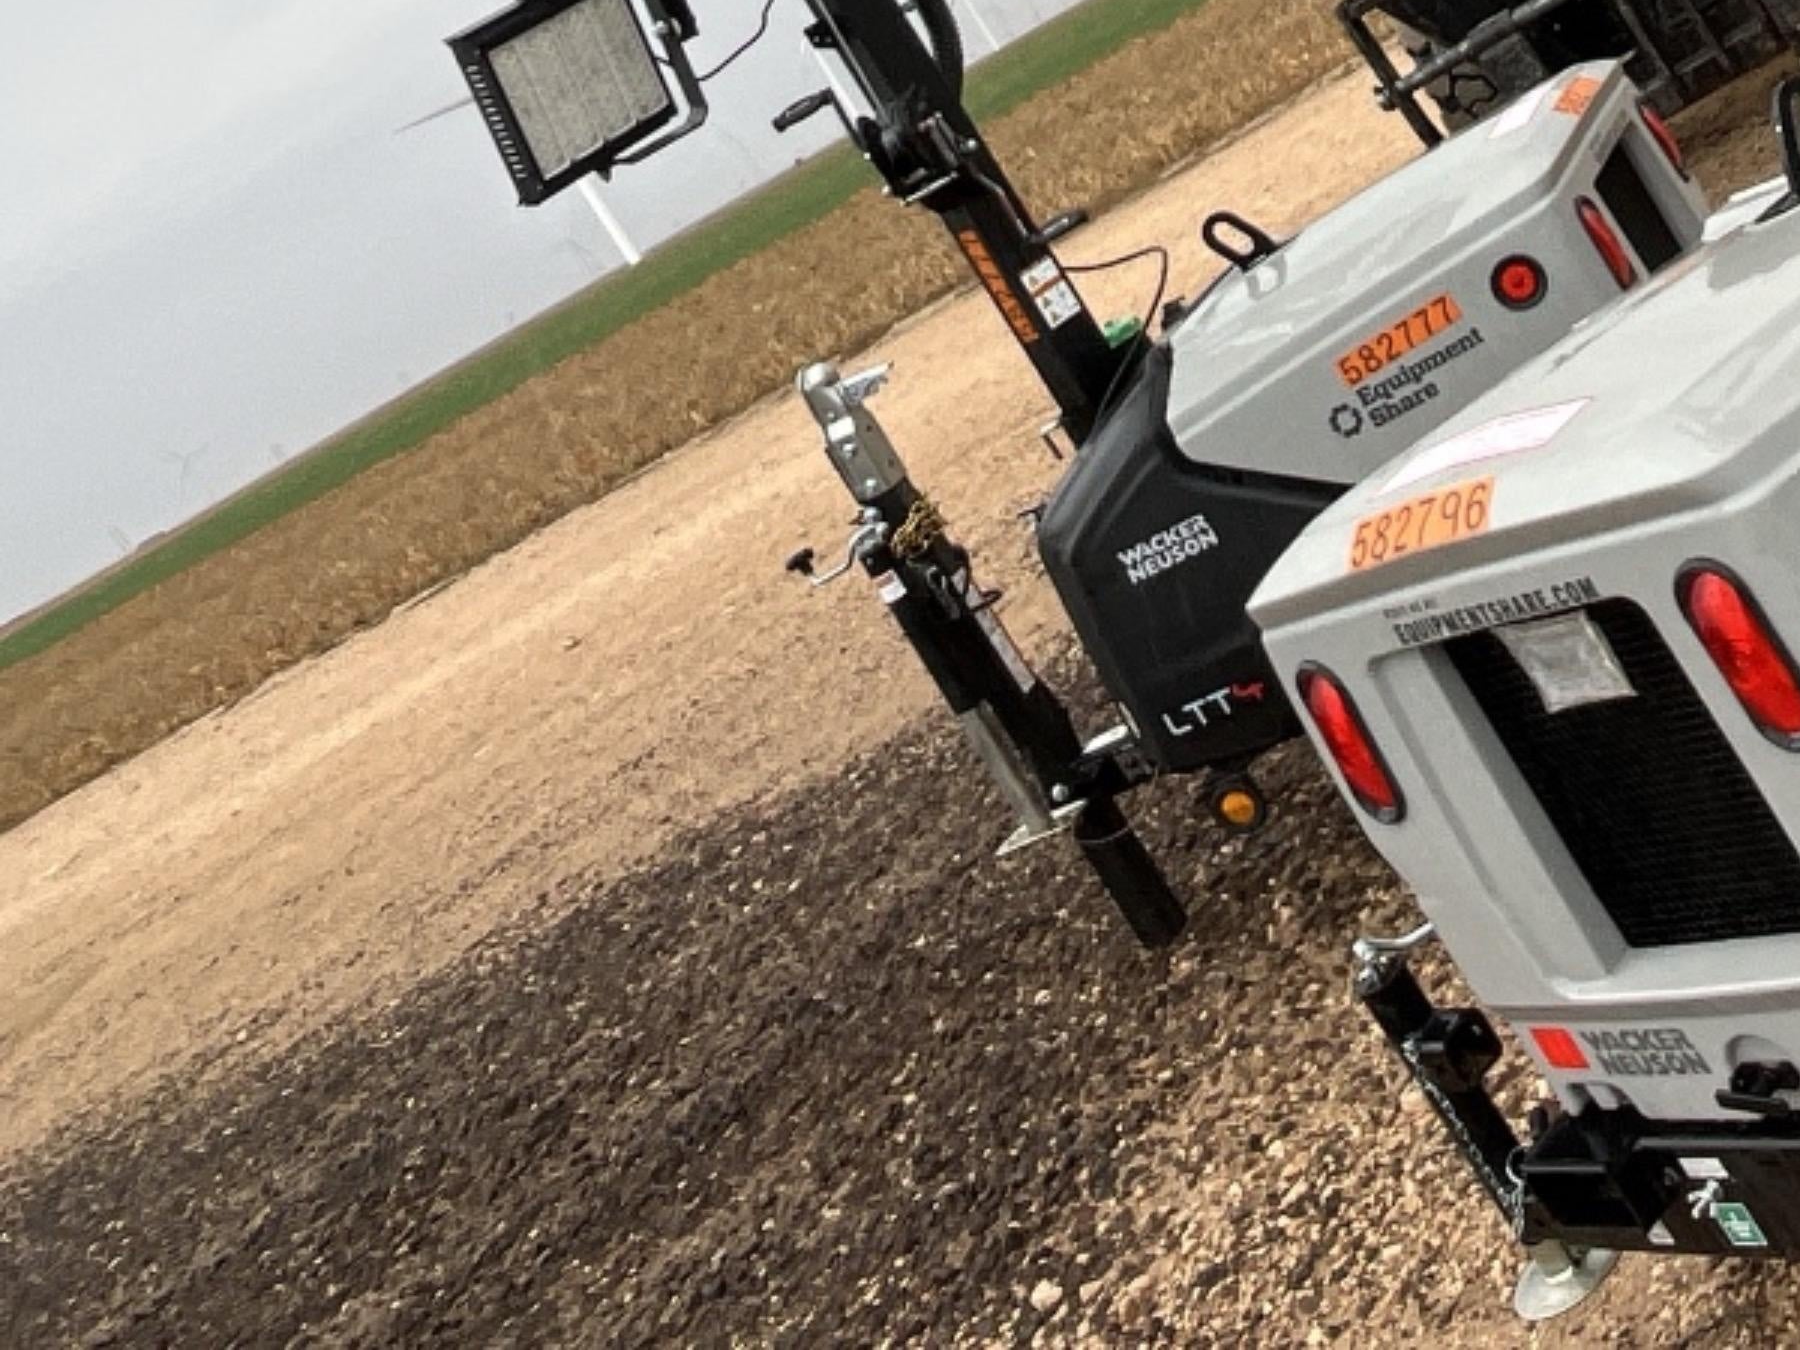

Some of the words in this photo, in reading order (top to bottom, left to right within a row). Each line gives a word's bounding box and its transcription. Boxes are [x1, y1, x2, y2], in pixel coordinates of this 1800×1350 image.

[1338, 296, 1453, 385] 582777
[1355, 326, 1485, 407] Equipment
[1368, 382, 1439, 427] Share
[1116, 513, 1209, 565] WACKER
[1351, 482, 1487, 568] 582796
[1127, 528, 1219, 585] NEUSON
[1393, 576, 1600, 645] EQUIPMENTSHARE.COM
[1579, 1028, 1696, 1050] WACKER
[1598, 1052, 1713, 1075] NEUSON
